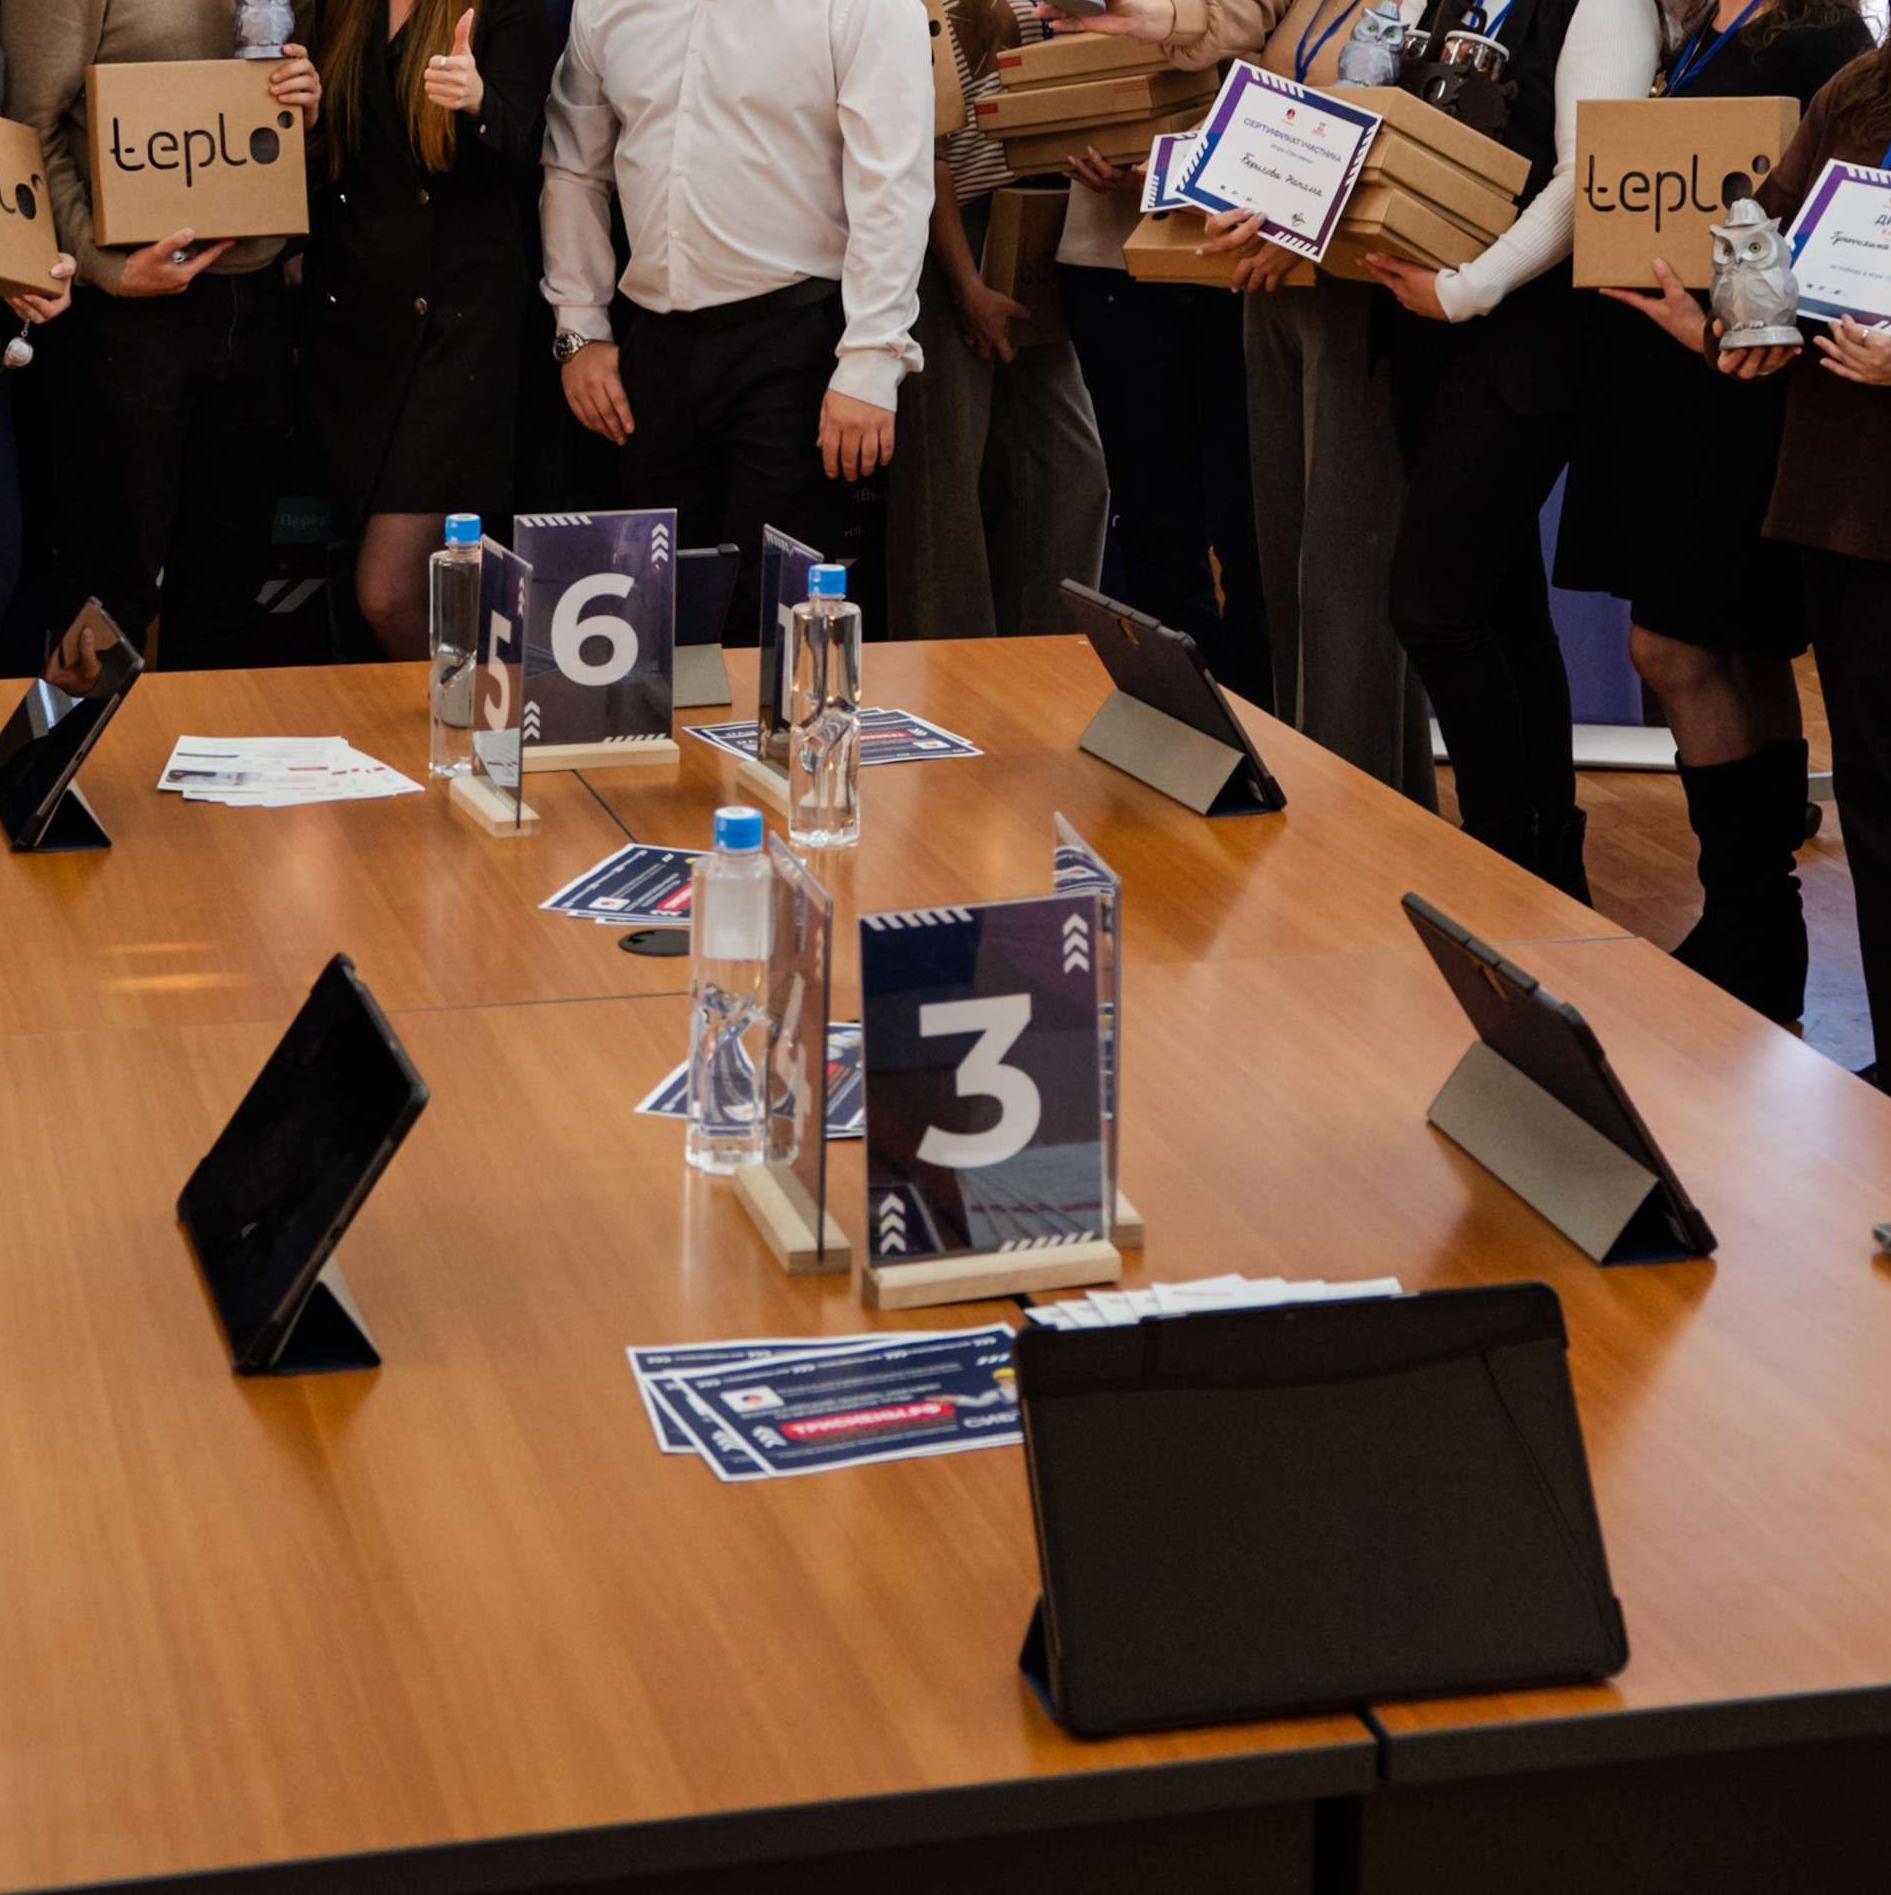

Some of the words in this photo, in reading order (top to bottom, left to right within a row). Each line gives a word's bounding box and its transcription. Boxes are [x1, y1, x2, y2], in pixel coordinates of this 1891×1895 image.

[110, 110, 294, 187] teplo
[1584, 153, 1771, 232] teplo
[483, 610, 512, 732] 5
[551, 572, 639, 686] 6
[916, 992, 1042, 1169] 3
[963, 1410, 1020, 1428] СИБ
